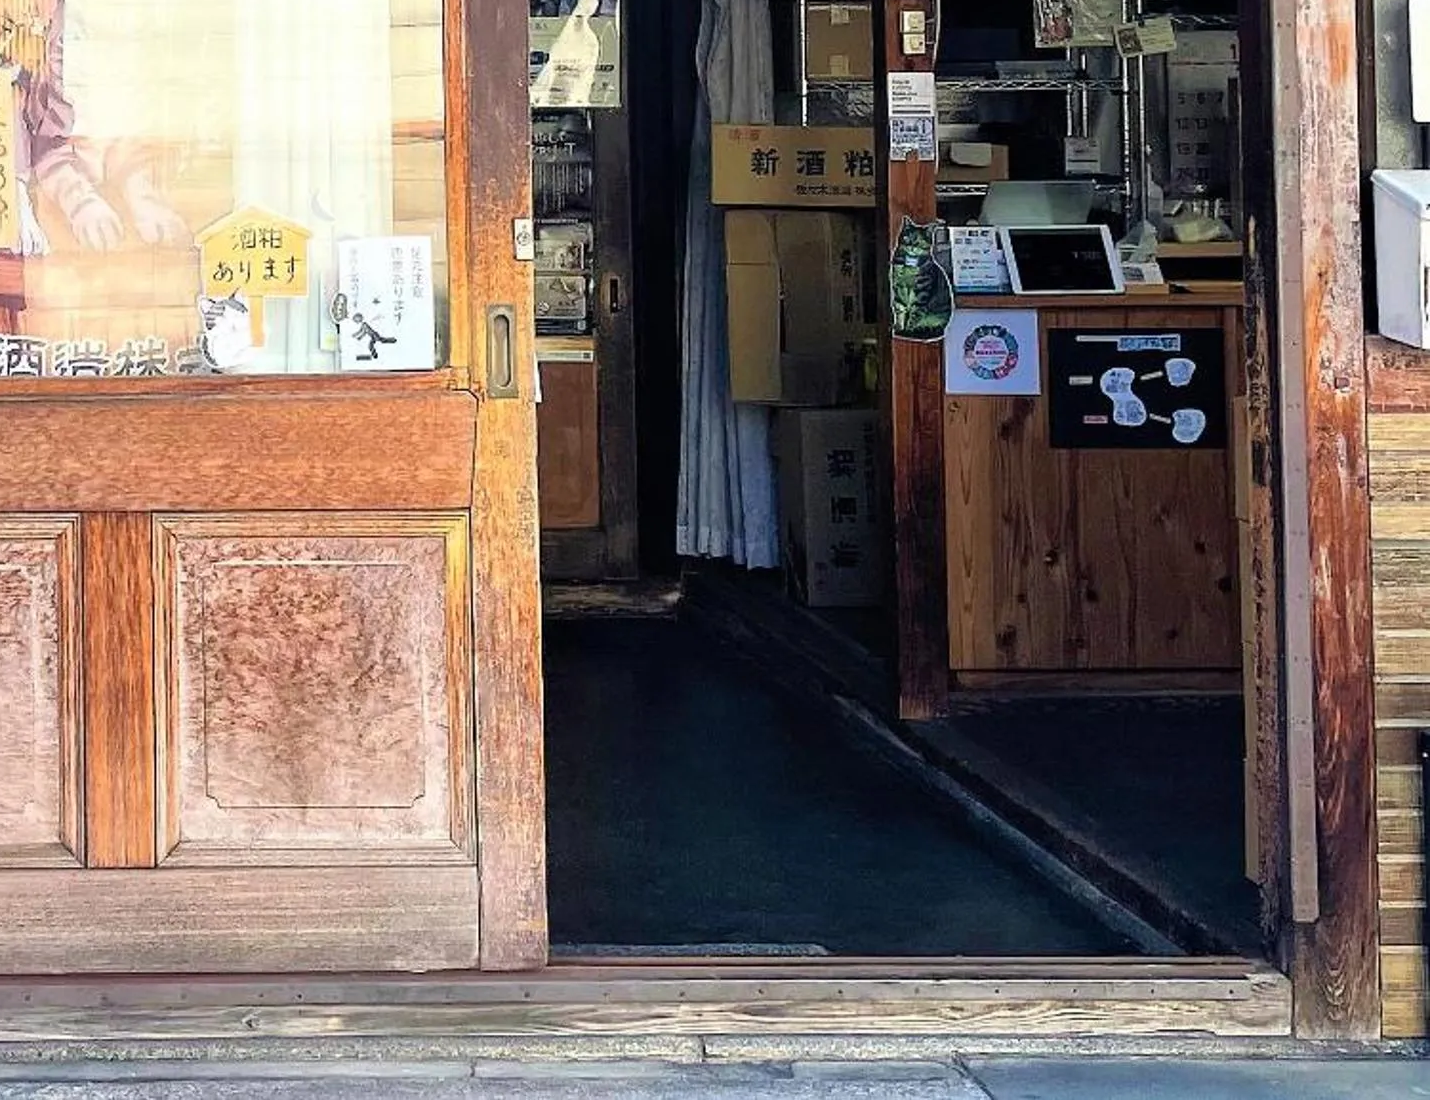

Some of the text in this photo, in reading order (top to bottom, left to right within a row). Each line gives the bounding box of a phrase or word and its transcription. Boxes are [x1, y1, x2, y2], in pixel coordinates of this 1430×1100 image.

[750, 148, 874, 177] 新酒粕
[232, 226, 283, 250] 酒粕
[212, 255, 303, 284] あります
